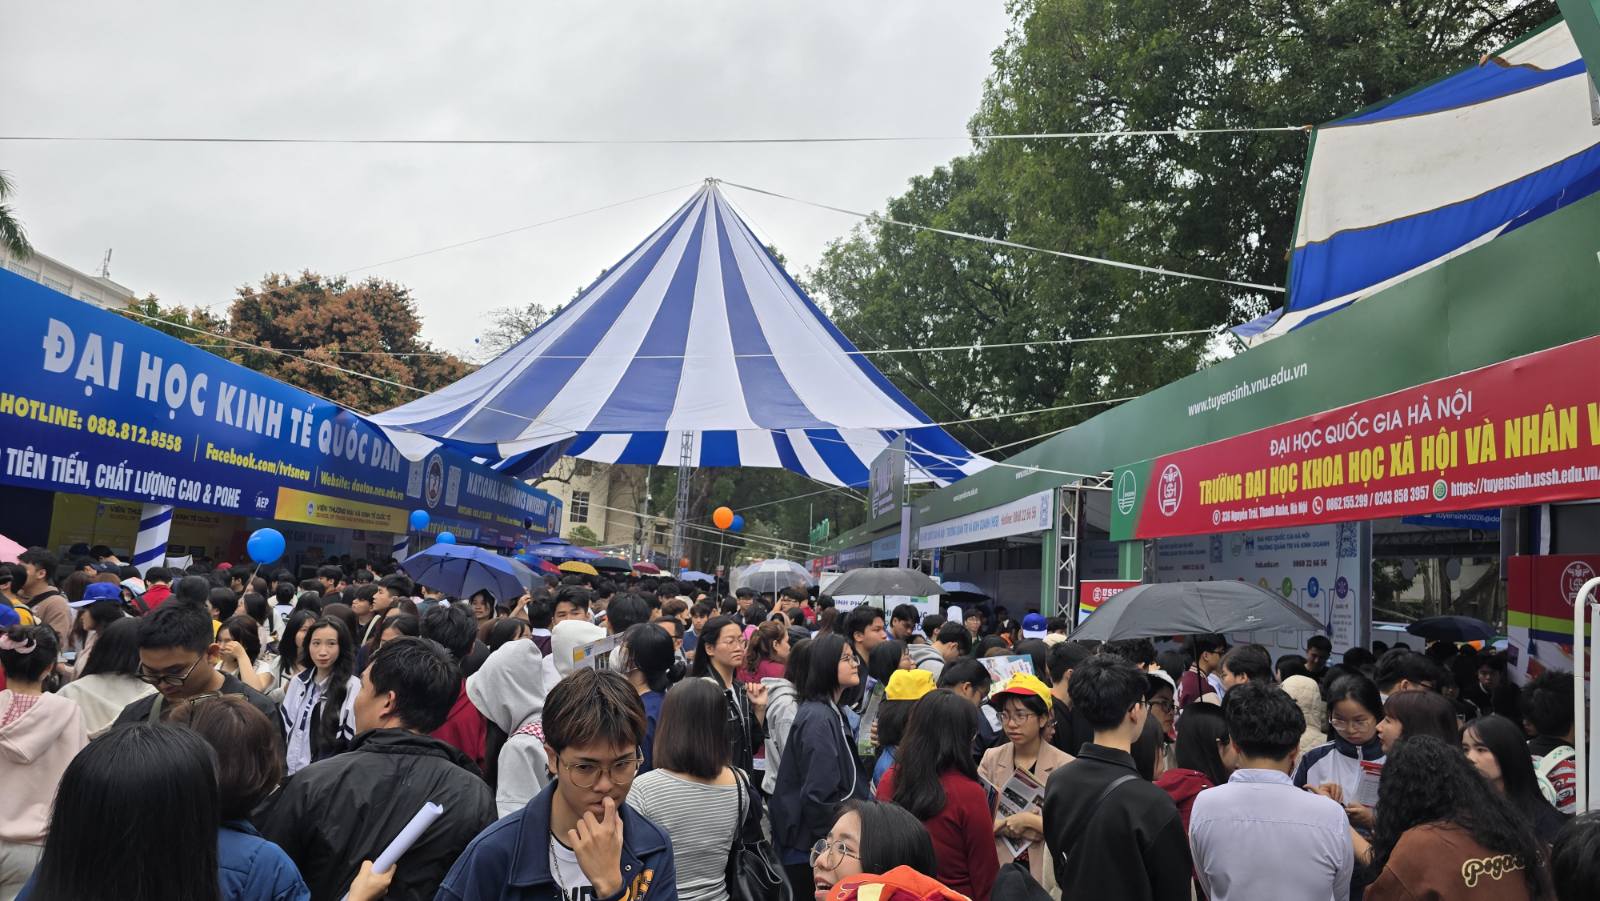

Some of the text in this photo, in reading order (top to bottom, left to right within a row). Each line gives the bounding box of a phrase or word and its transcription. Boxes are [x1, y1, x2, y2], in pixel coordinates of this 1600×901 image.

[43, 317, 124, 397] ĐẠI
[136, 351, 208, 420] HỌC
[216, 381, 283, 439] KINH
[290, 402, 316, 449] TẾ
[318, 419, 369, 464] QUỐC
[1188, 362, 1308, 416] www.tuyensinh.vnu.edu.vn
[0, 392, 182, 452] HOTLINE: 088.812.8558
[1270, 388, 1473, 458] ĐẠI HỌC QUỐC GIA HÀ NỘI
[7, 445, 242, 508] TIÊN TIẾN, CHẤT LƯỢNG CAO & POHE
[205, 442, 311, 481] Facebook.com/tvtsneu
[1199, 472, 1242, 505] TRƯỜNG
[1245, 468, 1266, 502] ĐẠI
[1269, 462, 1298, 499] HỌC
[1302, 453, 1343, 490] KHOA
[1348, 445, 1384, 488] HỌC
[1390, 434, 1415, 478] XÃ
[1421, 426, 1458, 476] HỘI
[1465, 418, 1497, 465] VÀ
[1504, 403, 1578, 459] NHÂN
[256, 496, 270, 509] AEP
[466, 471, 500, 501] NATIONAL
[1374, 491, 1392, 506] 0243
[1410, 485, 1430, 502] 3957
